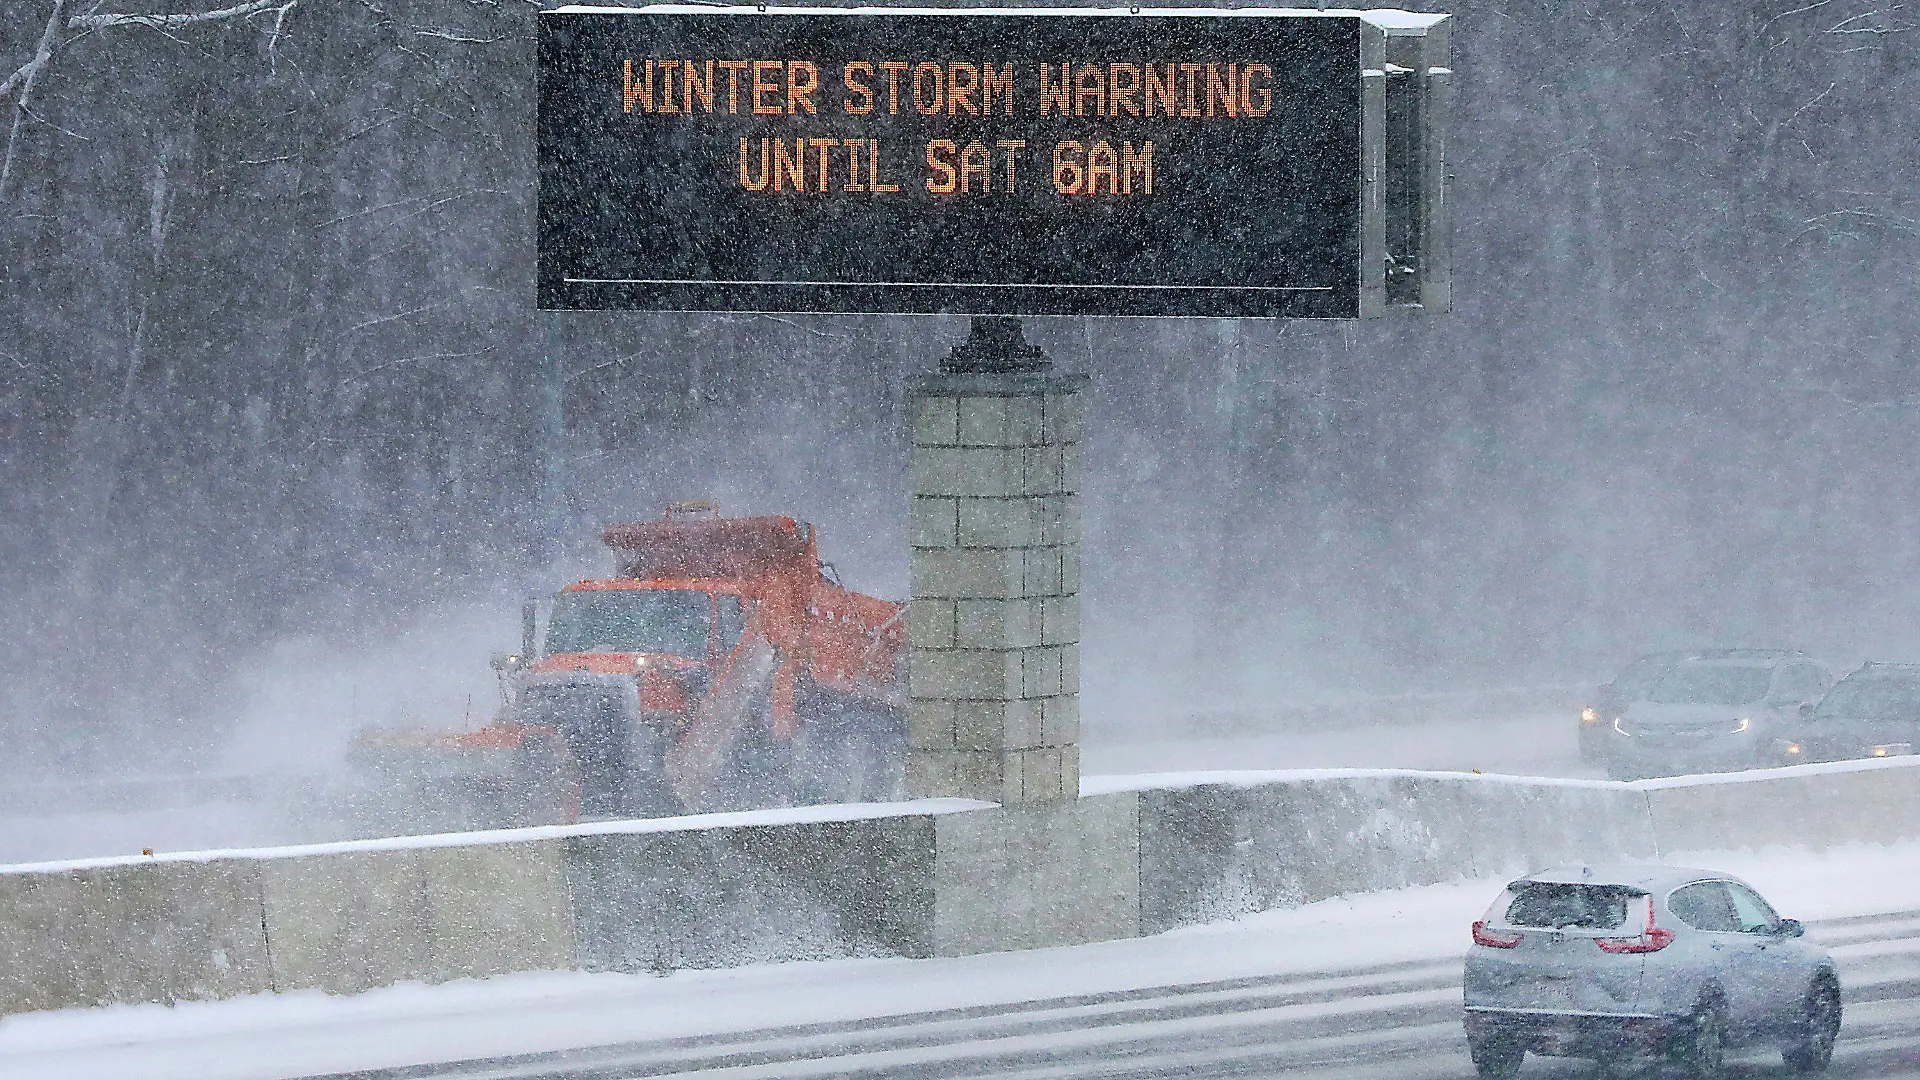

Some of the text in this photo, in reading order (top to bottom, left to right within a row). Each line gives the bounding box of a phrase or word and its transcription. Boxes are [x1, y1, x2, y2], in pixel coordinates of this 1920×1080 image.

[622, 59, 1274, 119] WINTER STORM WARNING
[738, 138, 1154, 196] UNTIL SAT 6AM
